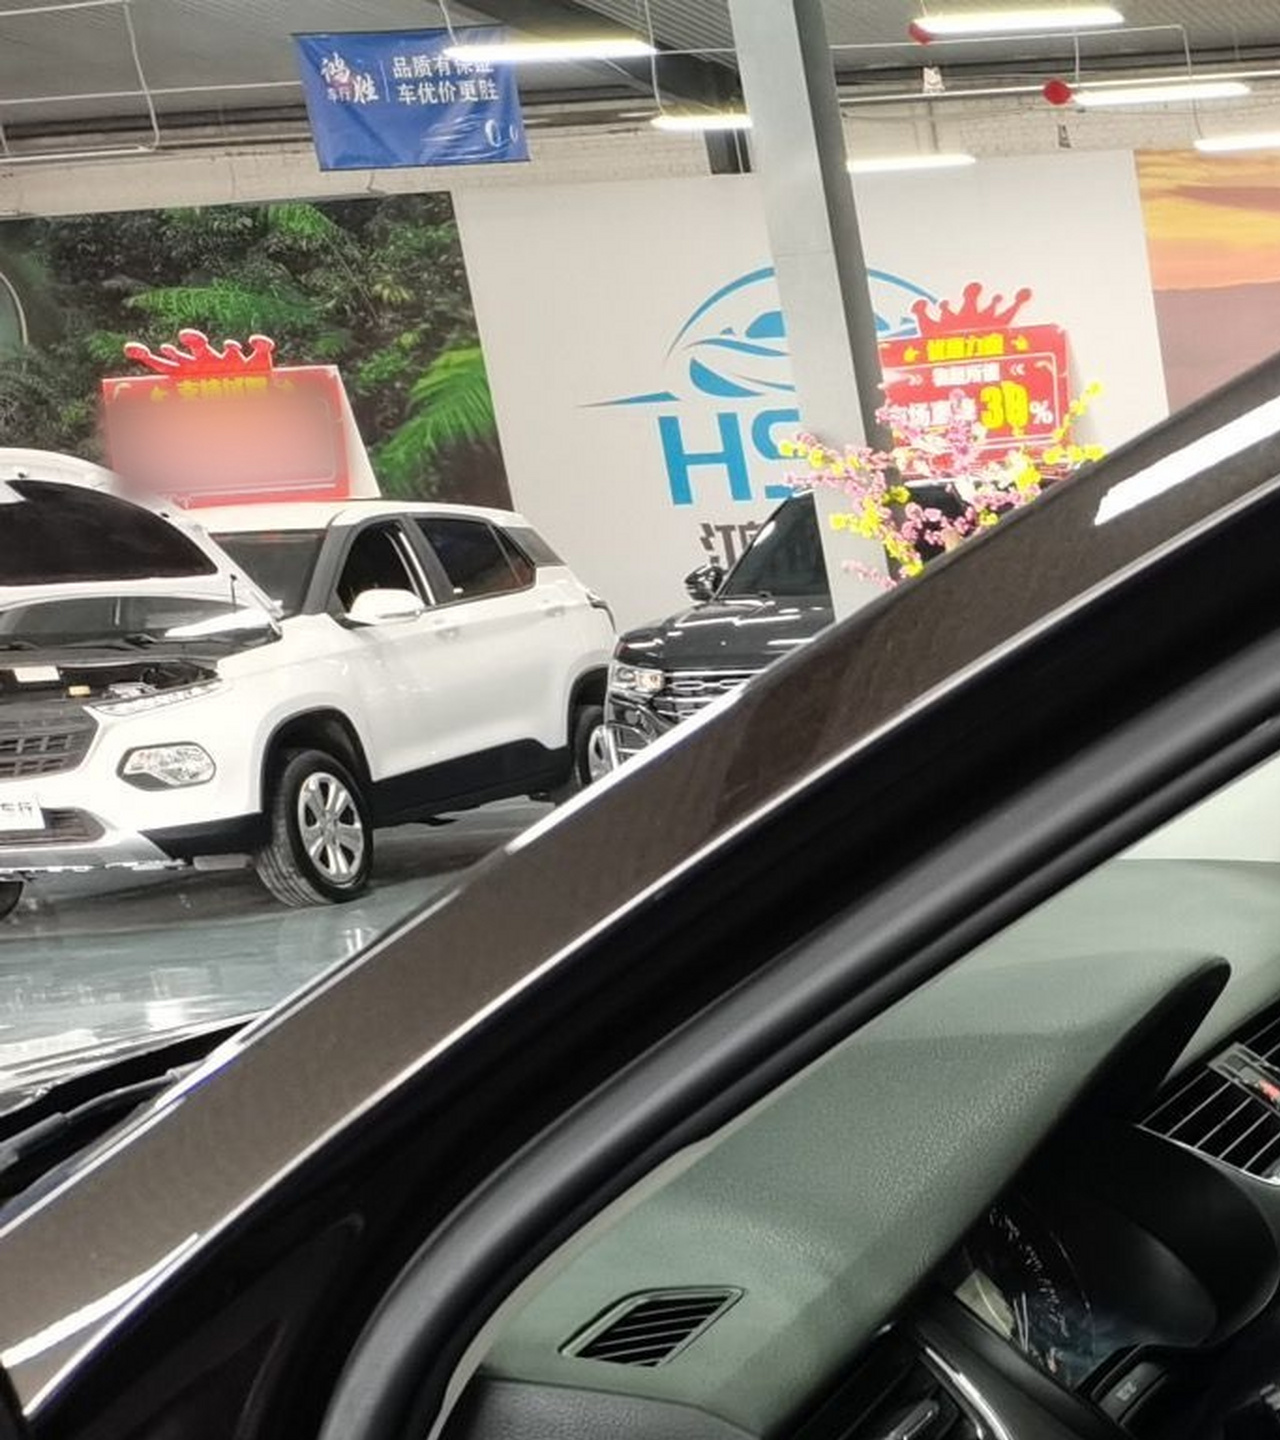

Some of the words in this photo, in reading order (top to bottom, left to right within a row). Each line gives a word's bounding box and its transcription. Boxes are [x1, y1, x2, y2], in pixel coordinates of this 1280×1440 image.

[397, 79, 500, 105] 车优价更胜
